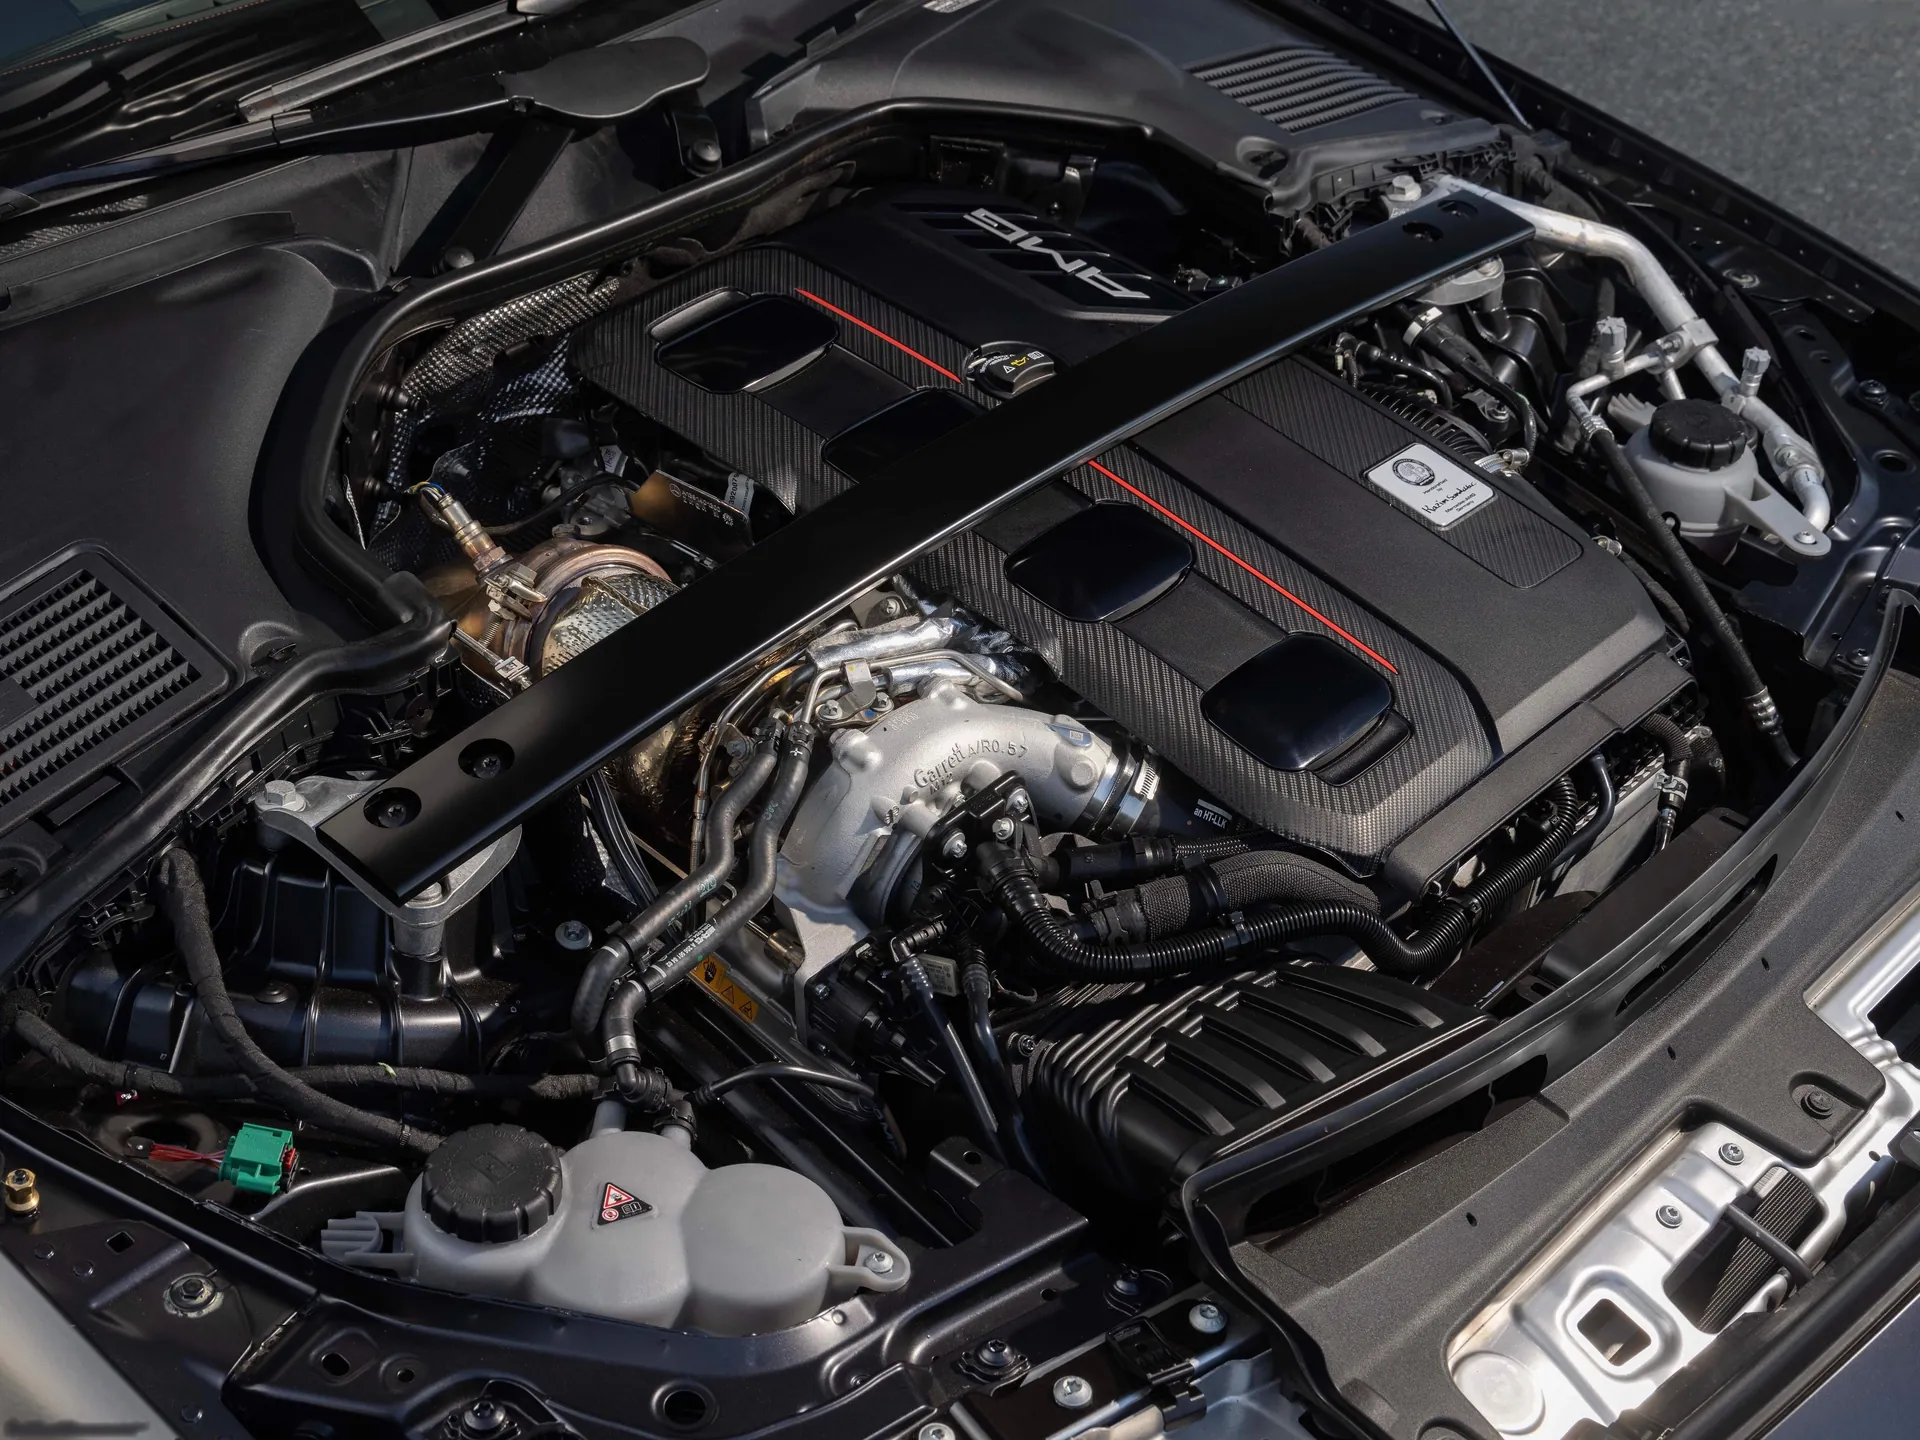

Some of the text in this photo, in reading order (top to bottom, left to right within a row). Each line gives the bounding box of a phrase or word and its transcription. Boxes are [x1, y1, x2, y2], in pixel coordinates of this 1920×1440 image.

[963, 208, 1150, 298] AMG
[914, 743, 965, 787] Garrett
[1203, 810, 1227, 829] HT-LLK
